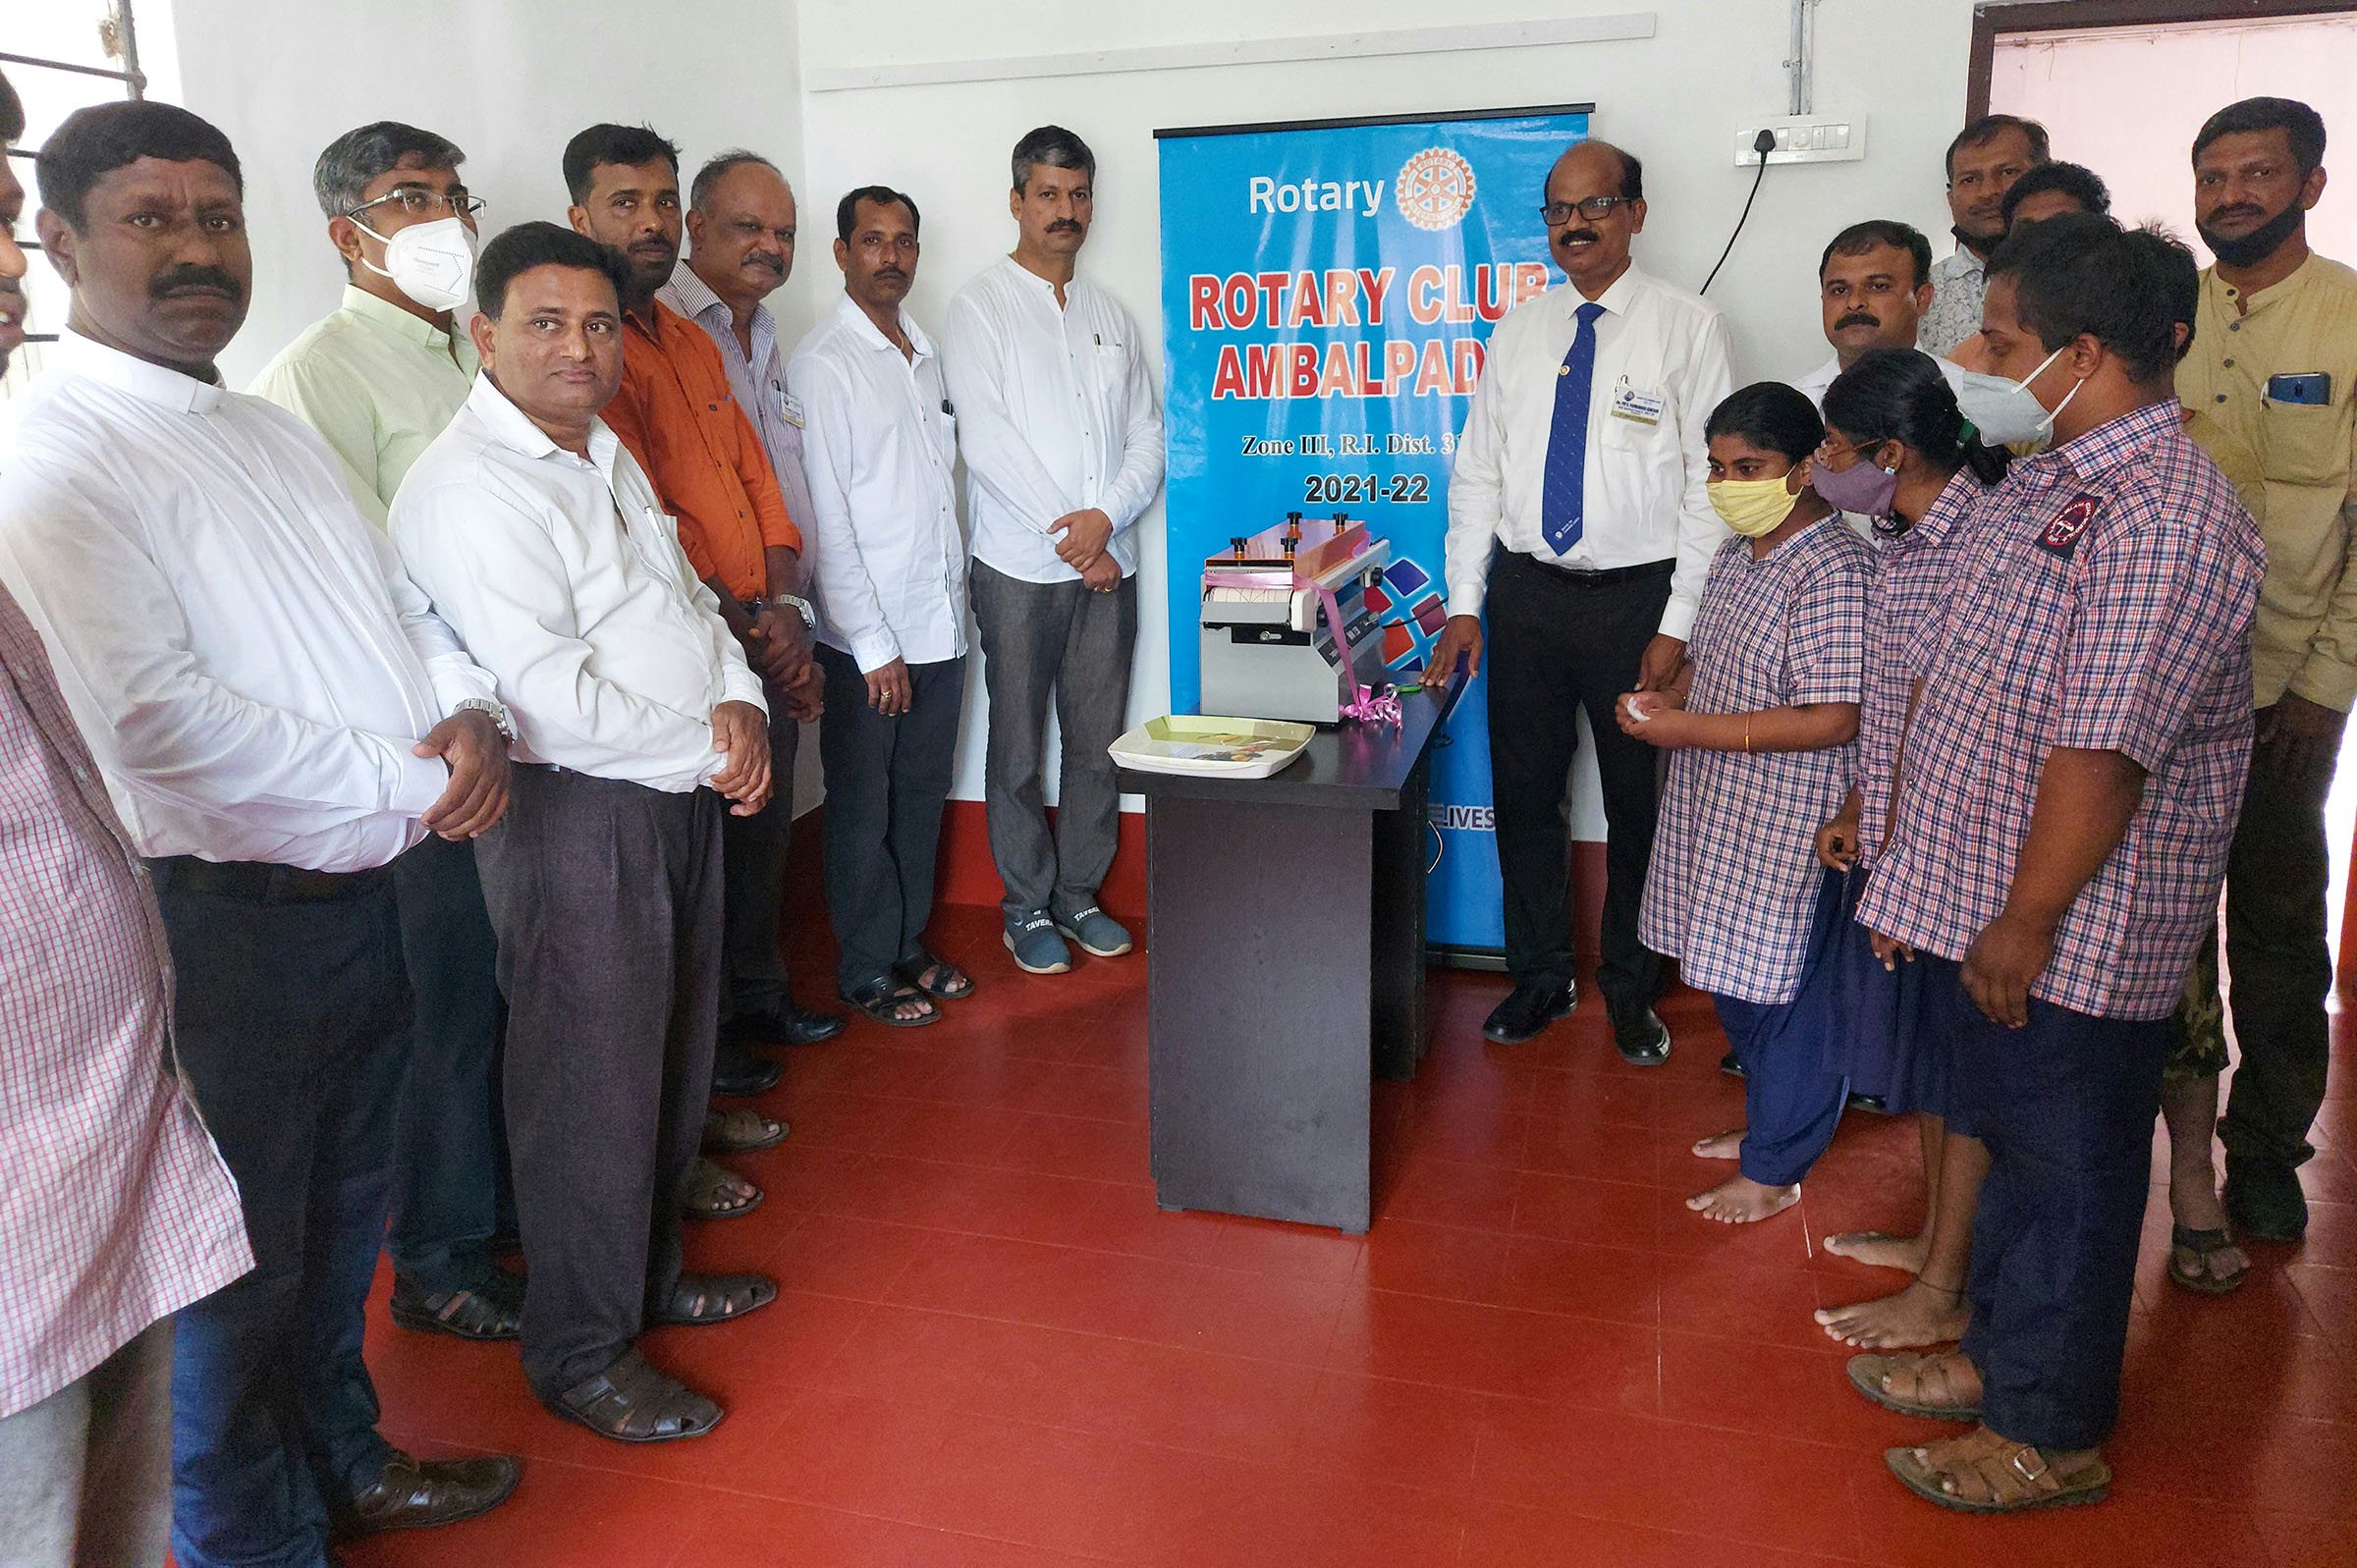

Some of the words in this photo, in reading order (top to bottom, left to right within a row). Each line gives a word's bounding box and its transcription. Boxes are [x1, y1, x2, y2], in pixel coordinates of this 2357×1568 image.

[1249, 177, 1385, 217] Rotary
[1190, 267, 1396, 331] ROTARY
[1407, 262, 1549, 324] CLUB
[1211, 339, 1488, 401] AMBALPAD
[1242, 436, 1293, 455] Zone
[1299, 434, 1336, 459] III,
[1341, 433, 1380, 455] R.I.
[1387, 433, 1435, 455] Dist.
[1441, 432, 1462, 455] 3
[1304, 474, 1429, 504] 2021-22
